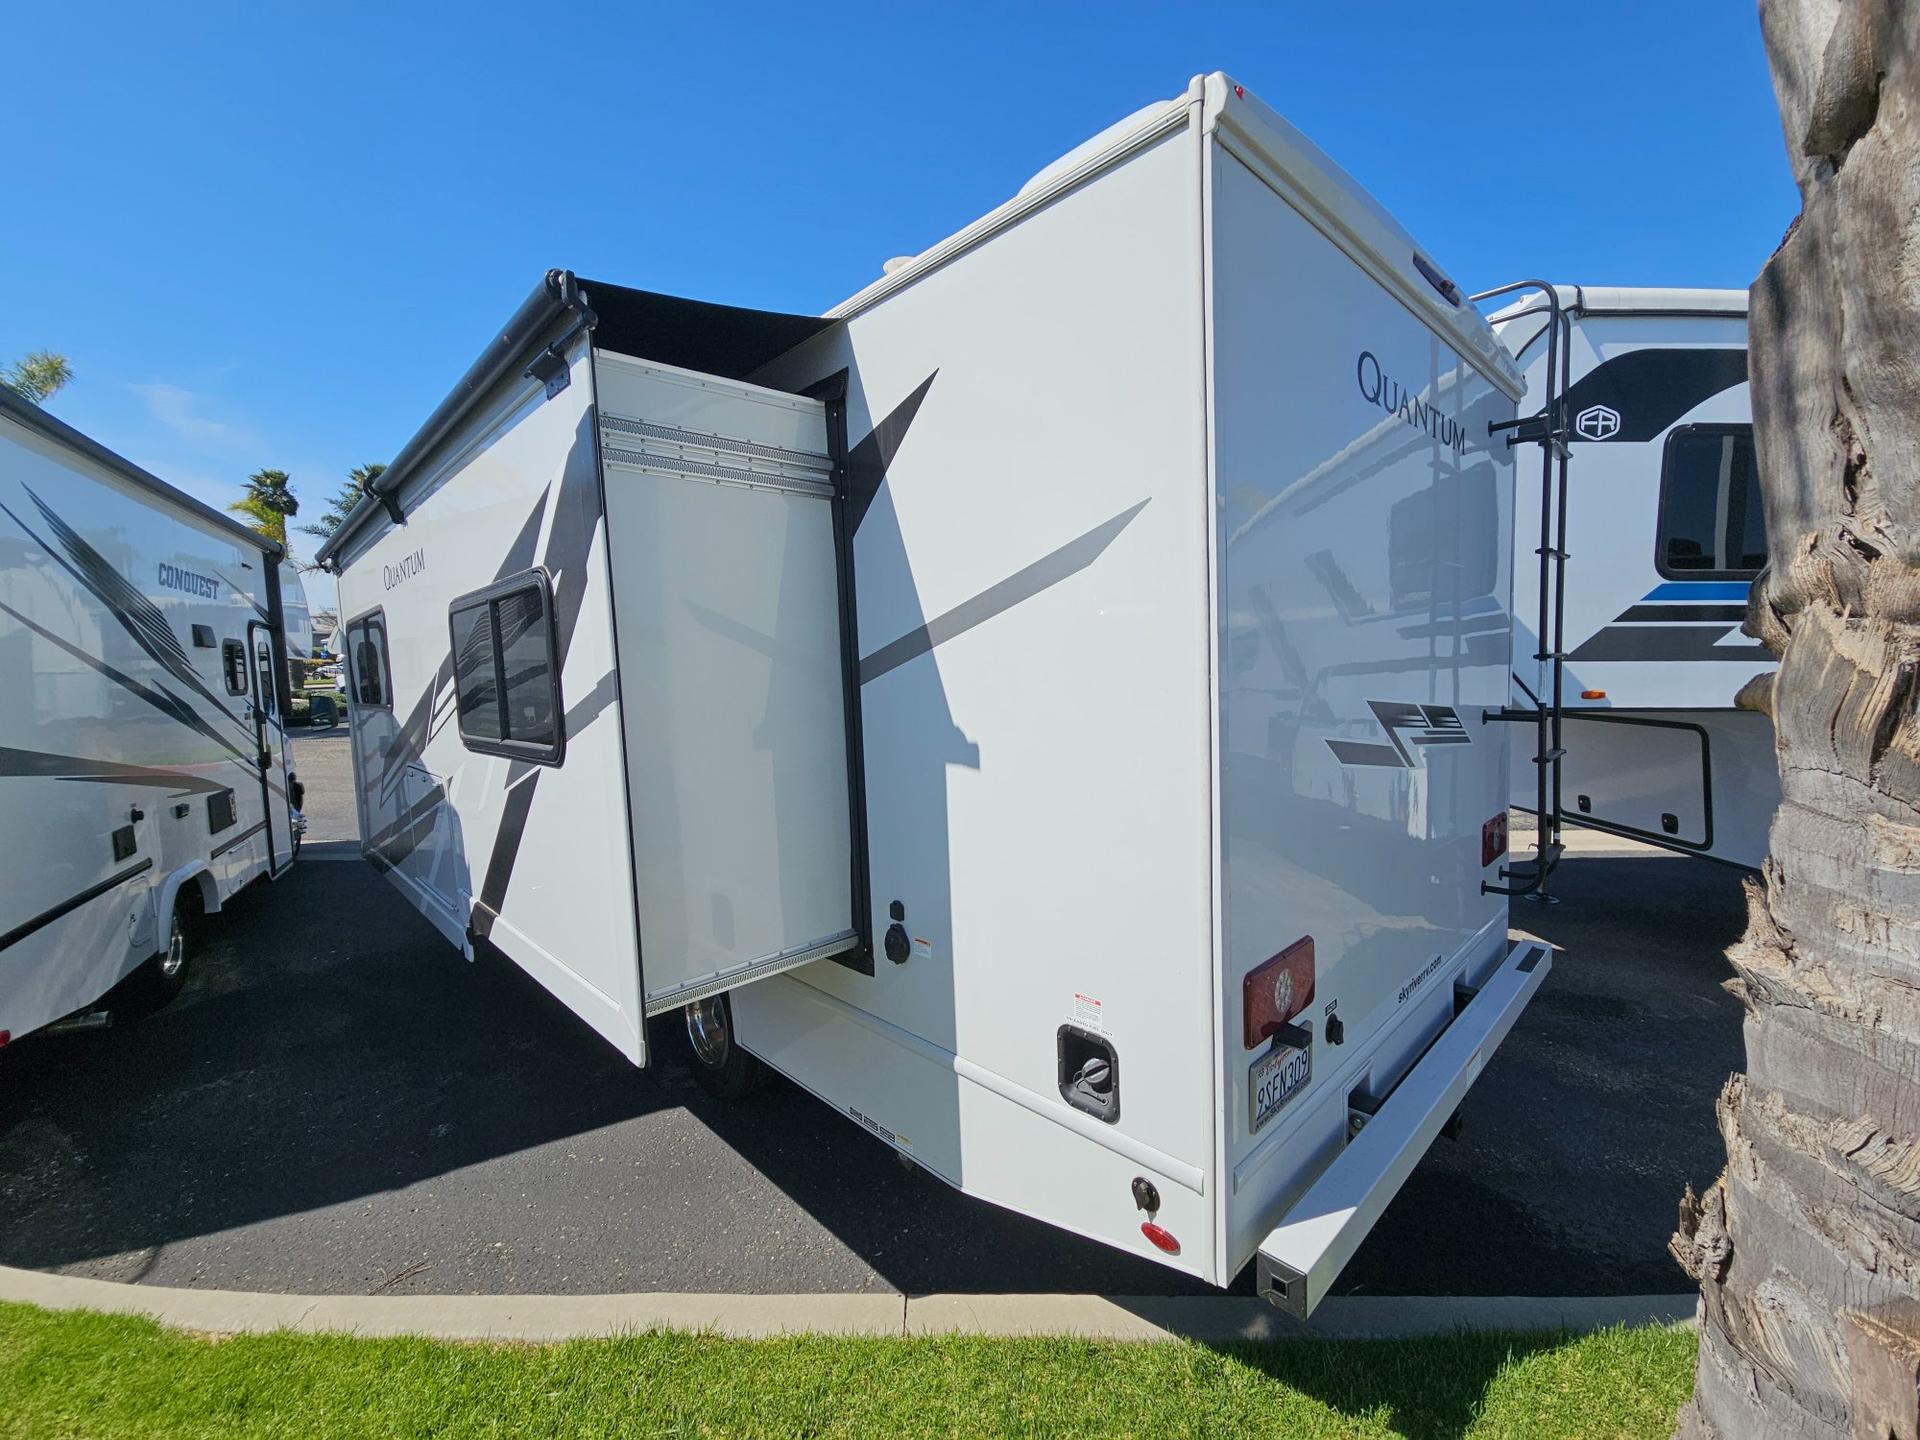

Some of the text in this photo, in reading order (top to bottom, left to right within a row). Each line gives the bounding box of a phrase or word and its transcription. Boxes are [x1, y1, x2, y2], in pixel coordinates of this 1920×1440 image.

[1357, 350, 1465, 456] QUANTUM
[158, 562, 219, 600] CONQUEST
[383, 547, 426, 591] QUANTUM
[1397, 954, 1442, 1004] skyriverrv.com
